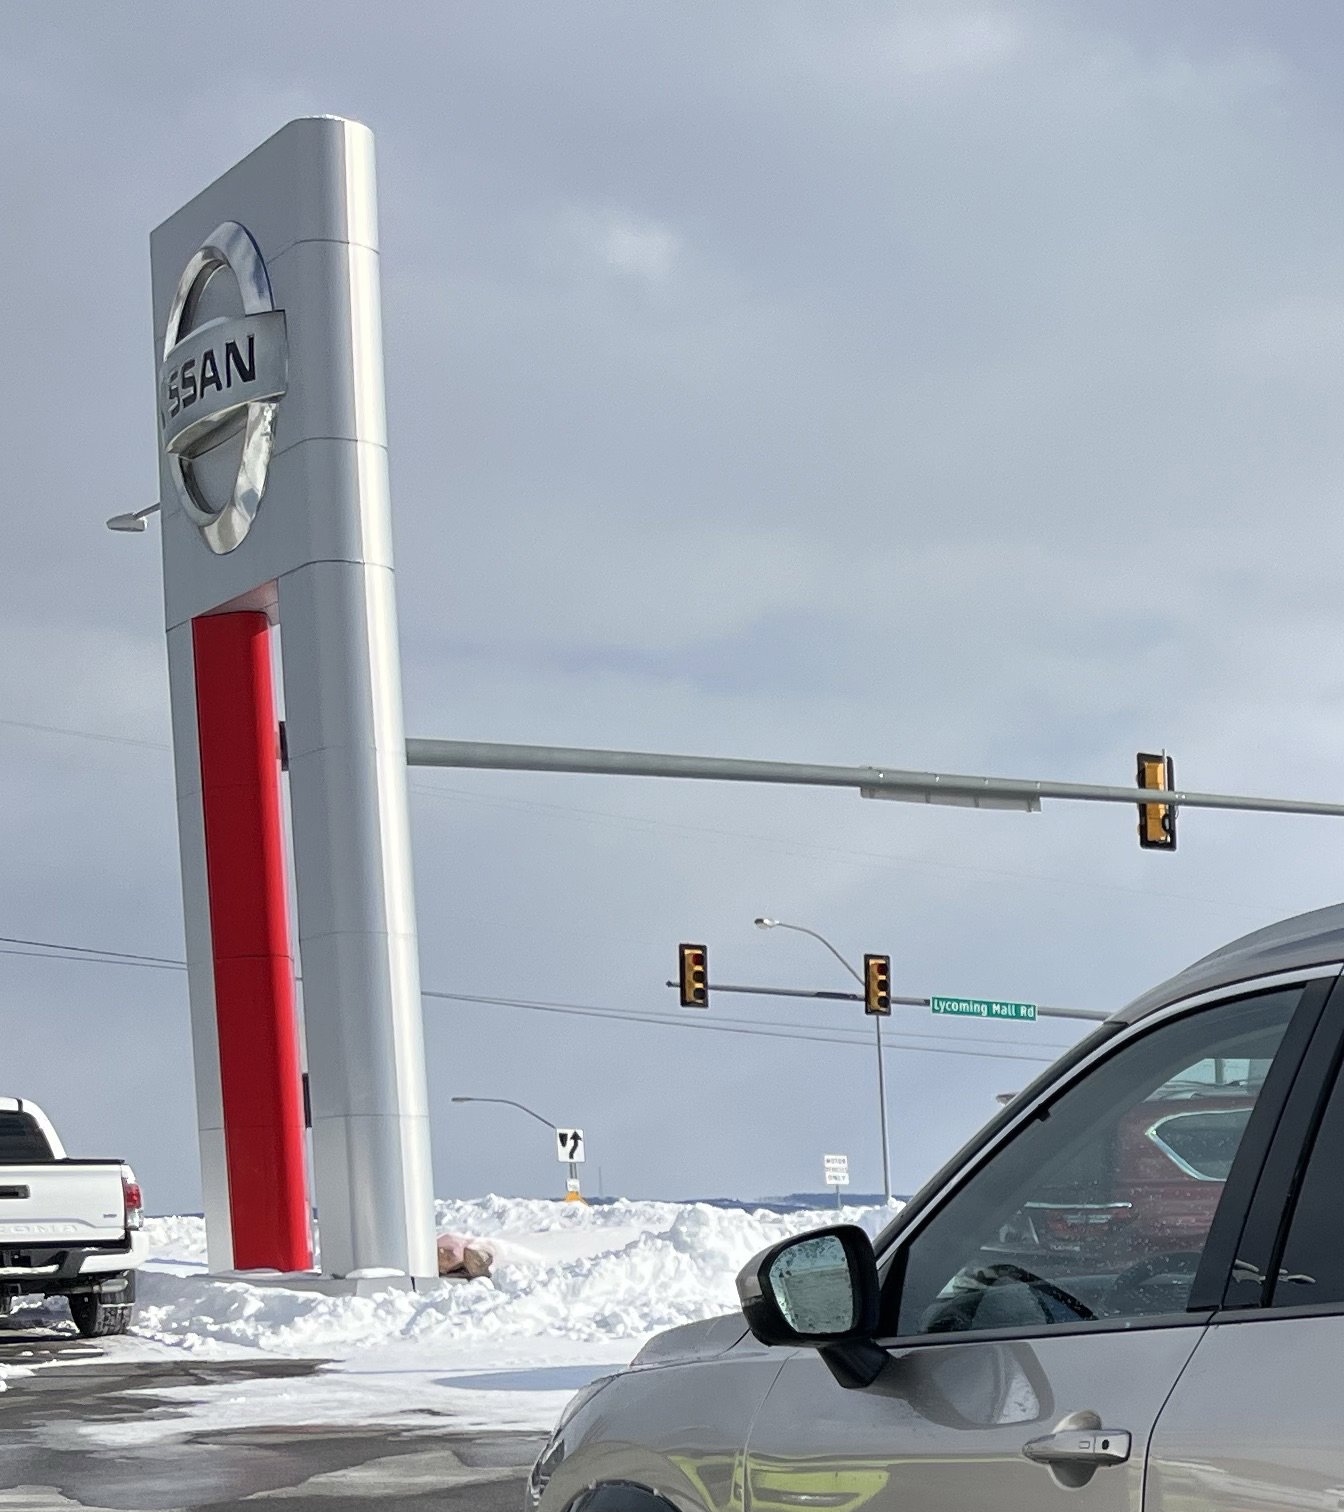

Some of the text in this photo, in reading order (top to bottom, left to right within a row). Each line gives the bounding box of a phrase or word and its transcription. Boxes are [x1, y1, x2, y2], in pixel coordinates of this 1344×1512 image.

[161, 334, 256, 430] SSAN
[934, 999, 1034, 1018] Lycoming Mall Rd
[0, 1224, 78, 1233] OMA
